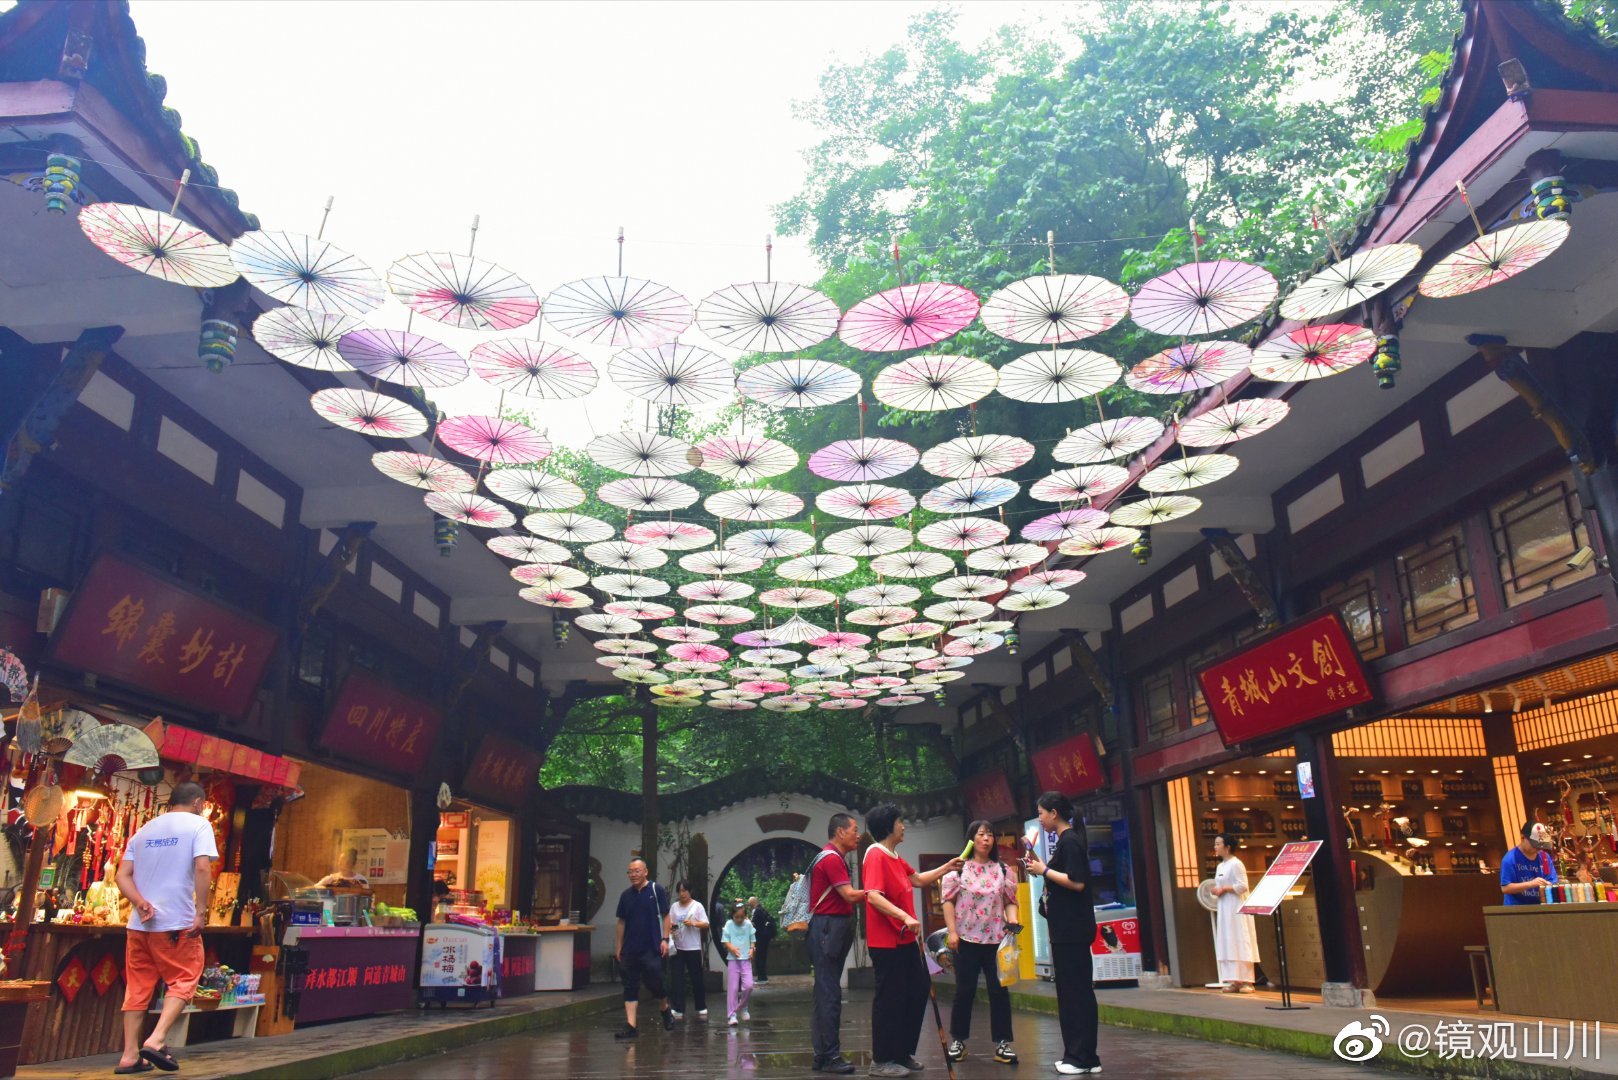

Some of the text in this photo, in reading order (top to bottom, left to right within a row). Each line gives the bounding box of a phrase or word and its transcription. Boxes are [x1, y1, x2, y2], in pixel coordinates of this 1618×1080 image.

[100, 593, 247, 688] 錦囊妙計
[1221, 634, 1346, 716] 青城山文創
[363, 964, 406, 986] 问道青城山
